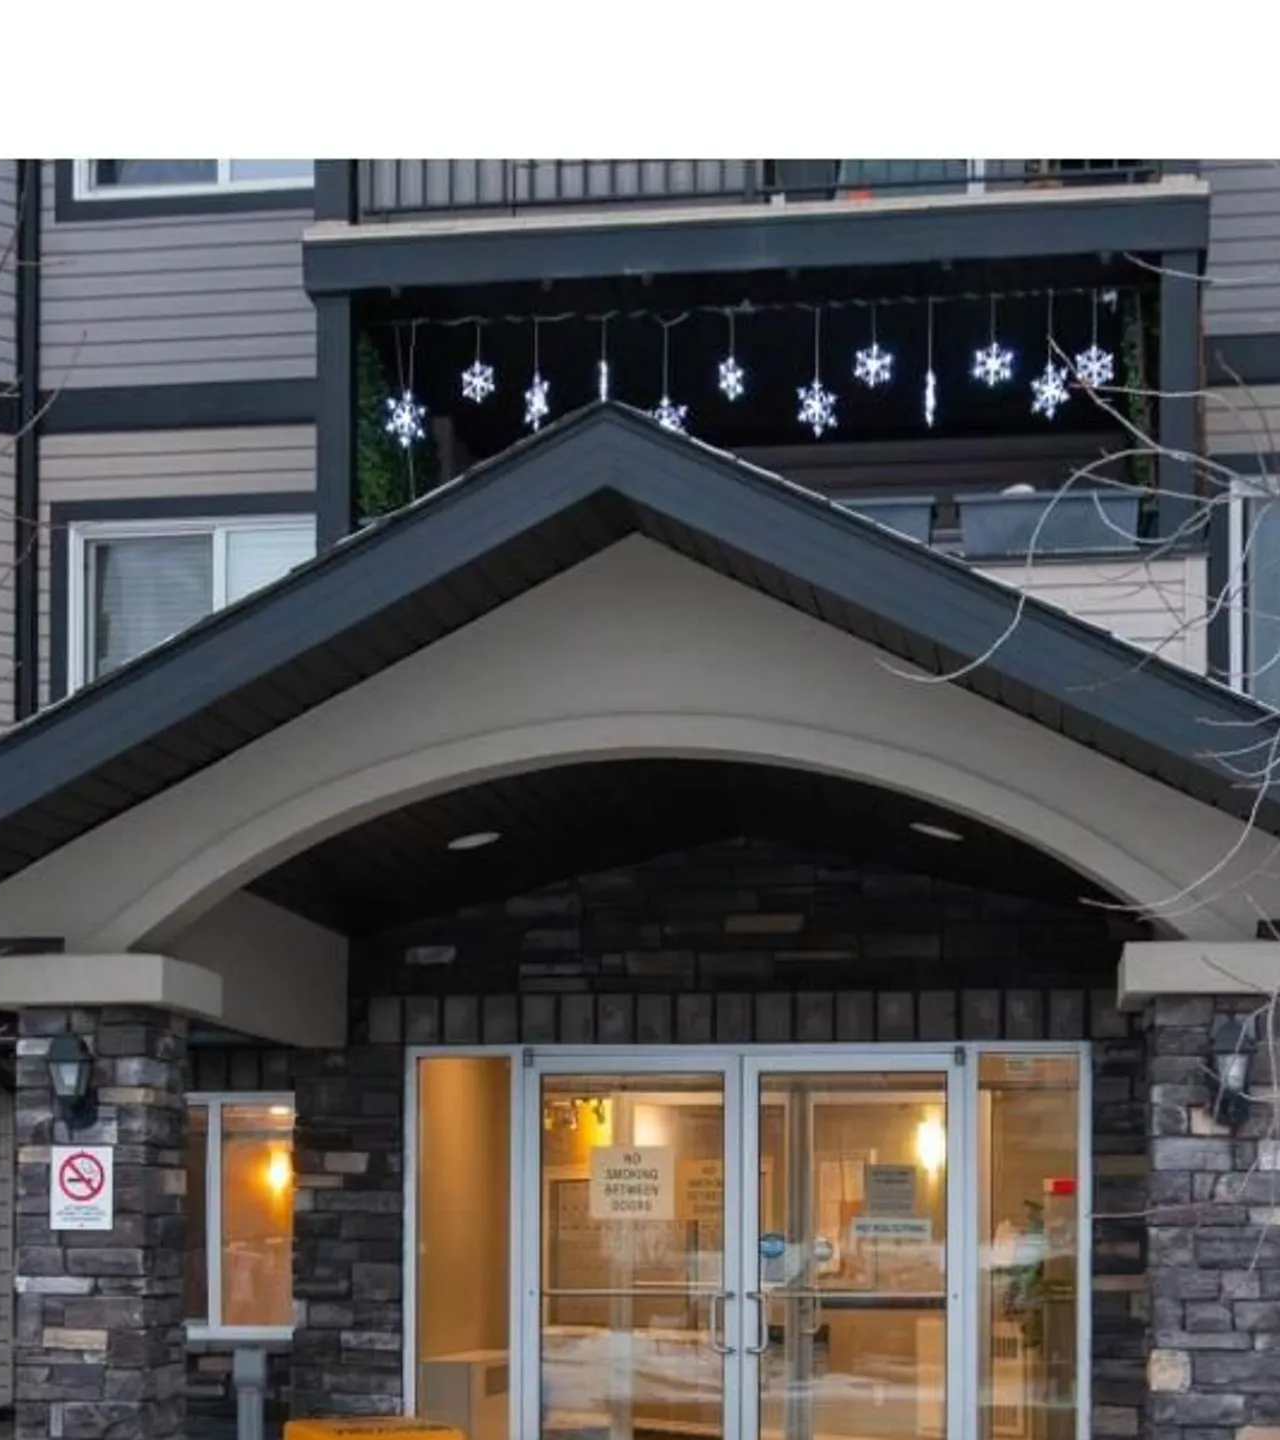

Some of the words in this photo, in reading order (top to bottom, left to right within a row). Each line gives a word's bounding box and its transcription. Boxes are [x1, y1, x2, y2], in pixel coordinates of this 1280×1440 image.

[622, 1151, 642, 1165] NO
[604, 1168, 658, 1180] SMOKING
[603, 1183, 658, 1196] BETWEEN
